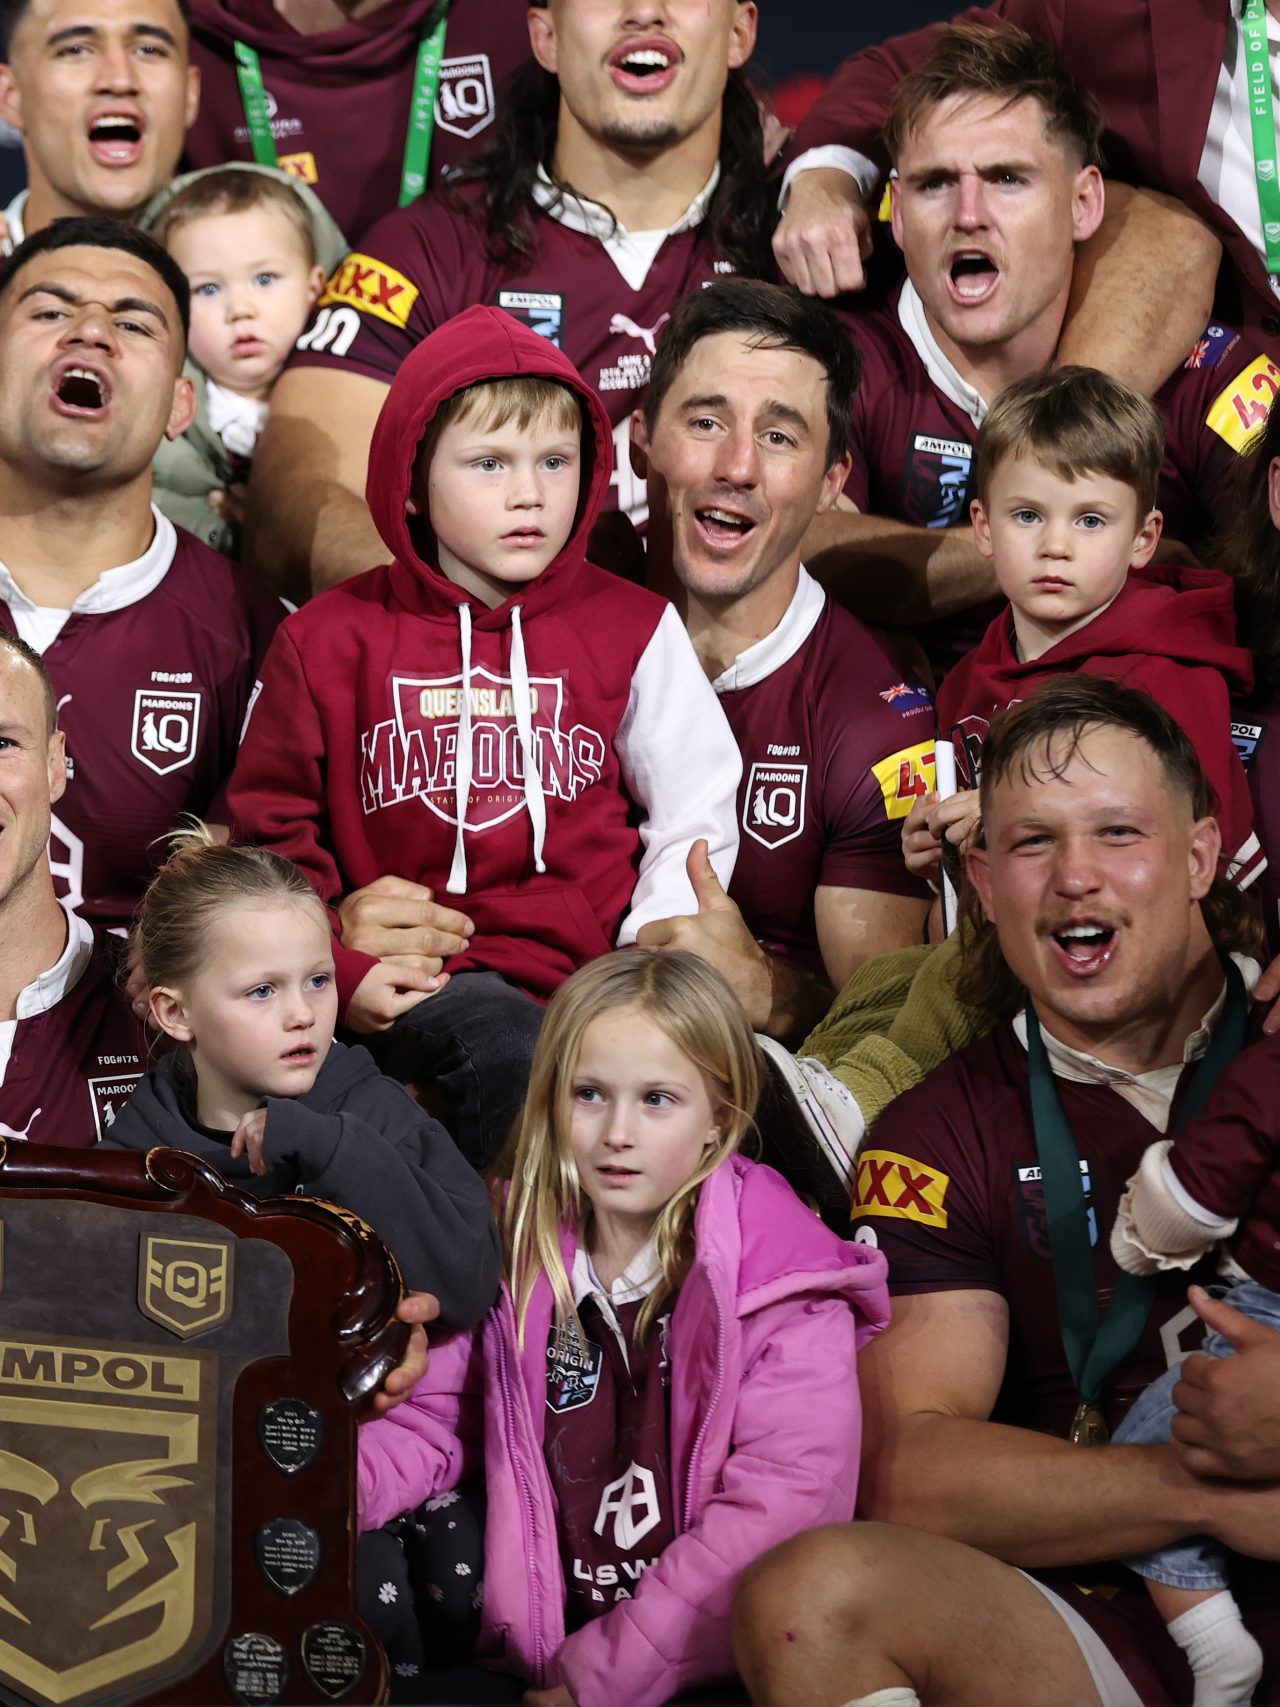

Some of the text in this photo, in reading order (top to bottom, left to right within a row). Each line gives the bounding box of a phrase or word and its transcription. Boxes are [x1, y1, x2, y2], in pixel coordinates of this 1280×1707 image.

[1250, 28, 1262, 52] OF
[1252, 61, 1268, 116] FIELD
[921, 440, 966, 454] AMPOL
[141, 698, 194, 712] MAROONS
[419, 686, 539, 719] QUENSLAD
[766, 743, 801, 757] FOG#193
[755, 771, 801, 784] MAROONS
[430, 796, 454, 805] STAT
[487, 794, 526, 804] ORIGIN
[97, 1055, 139, 1066] FOG#176
[96, 1083, 137, 1096] MAROO
[546, 1347, 594, 1372] ORIGIN
